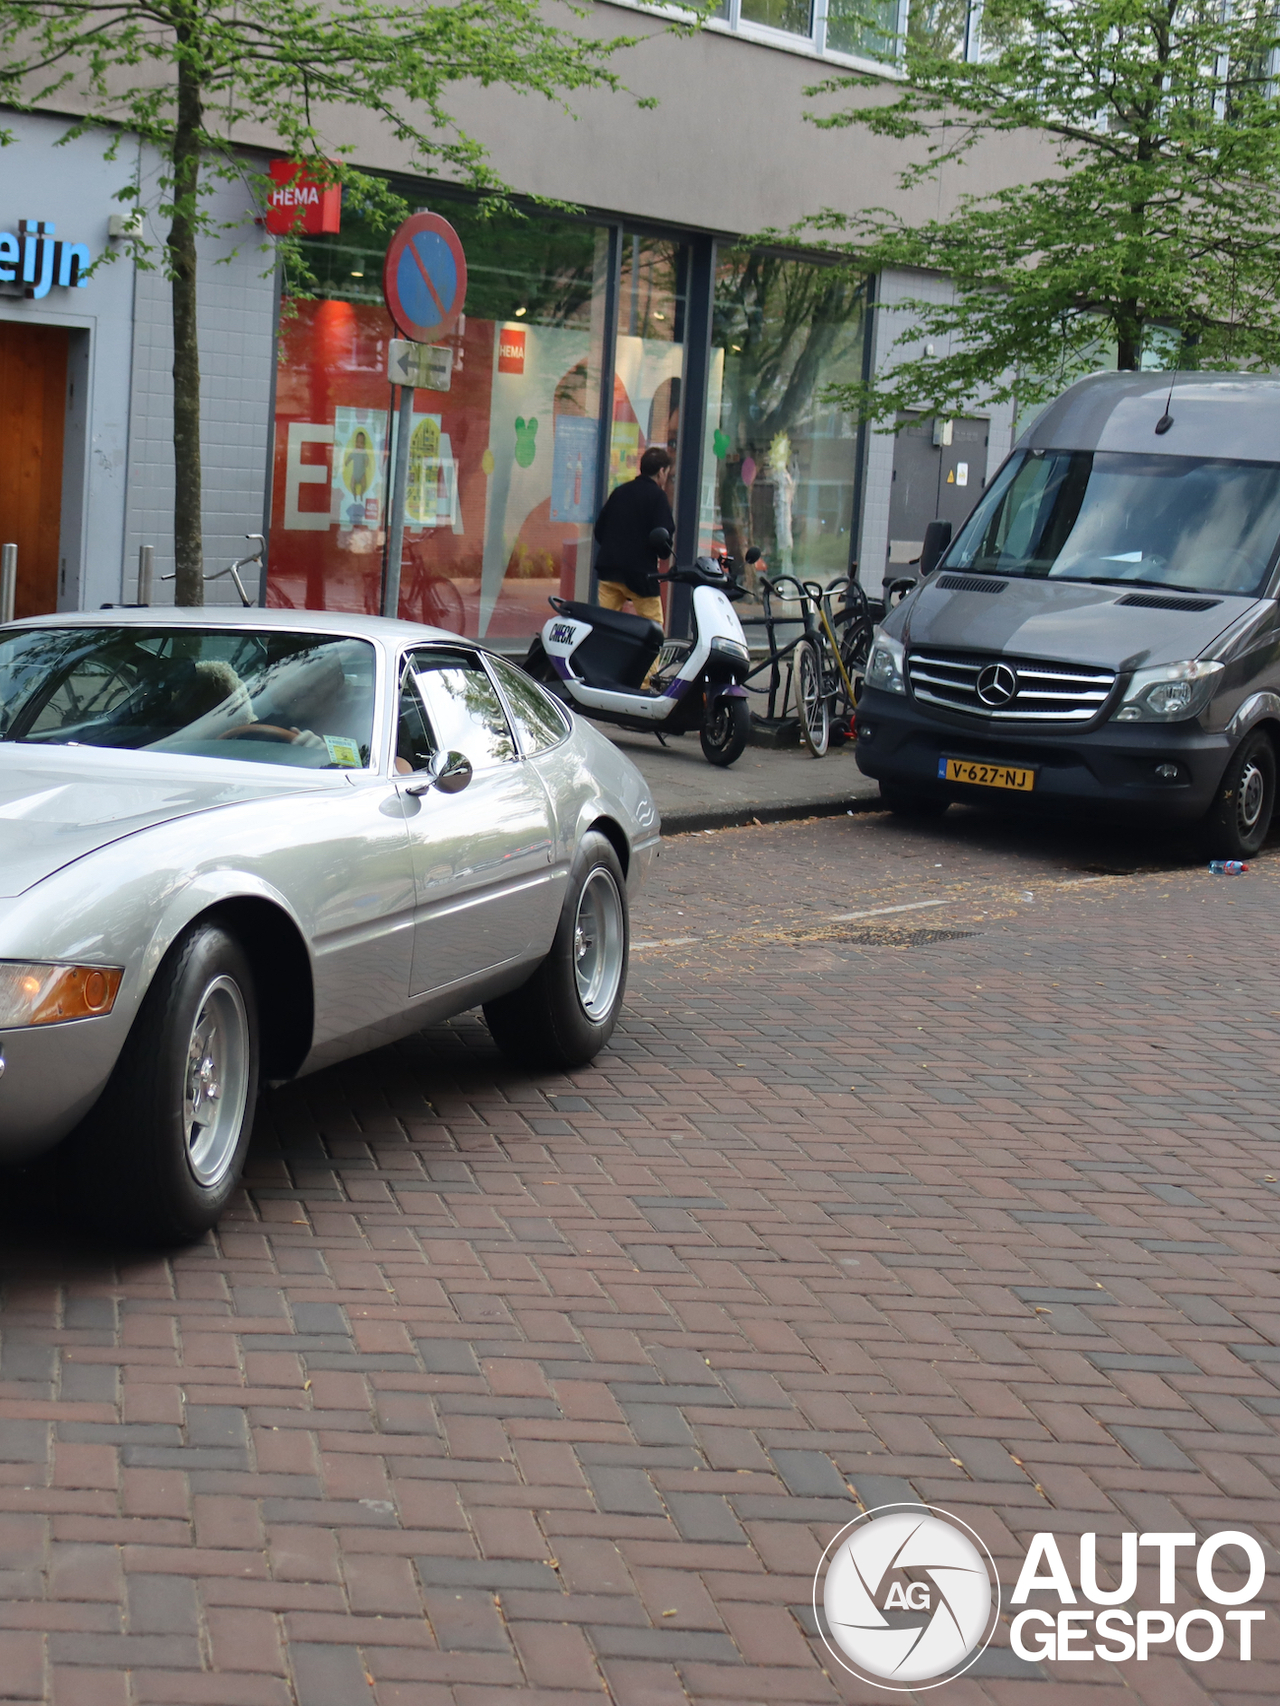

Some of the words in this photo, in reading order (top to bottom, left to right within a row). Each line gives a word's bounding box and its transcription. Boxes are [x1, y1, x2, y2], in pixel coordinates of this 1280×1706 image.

[272, 186, 319, 206] HEMA
[499, 344, 524, 359] HEMA
[952, 761, 1027, 788] V-627-NJ
